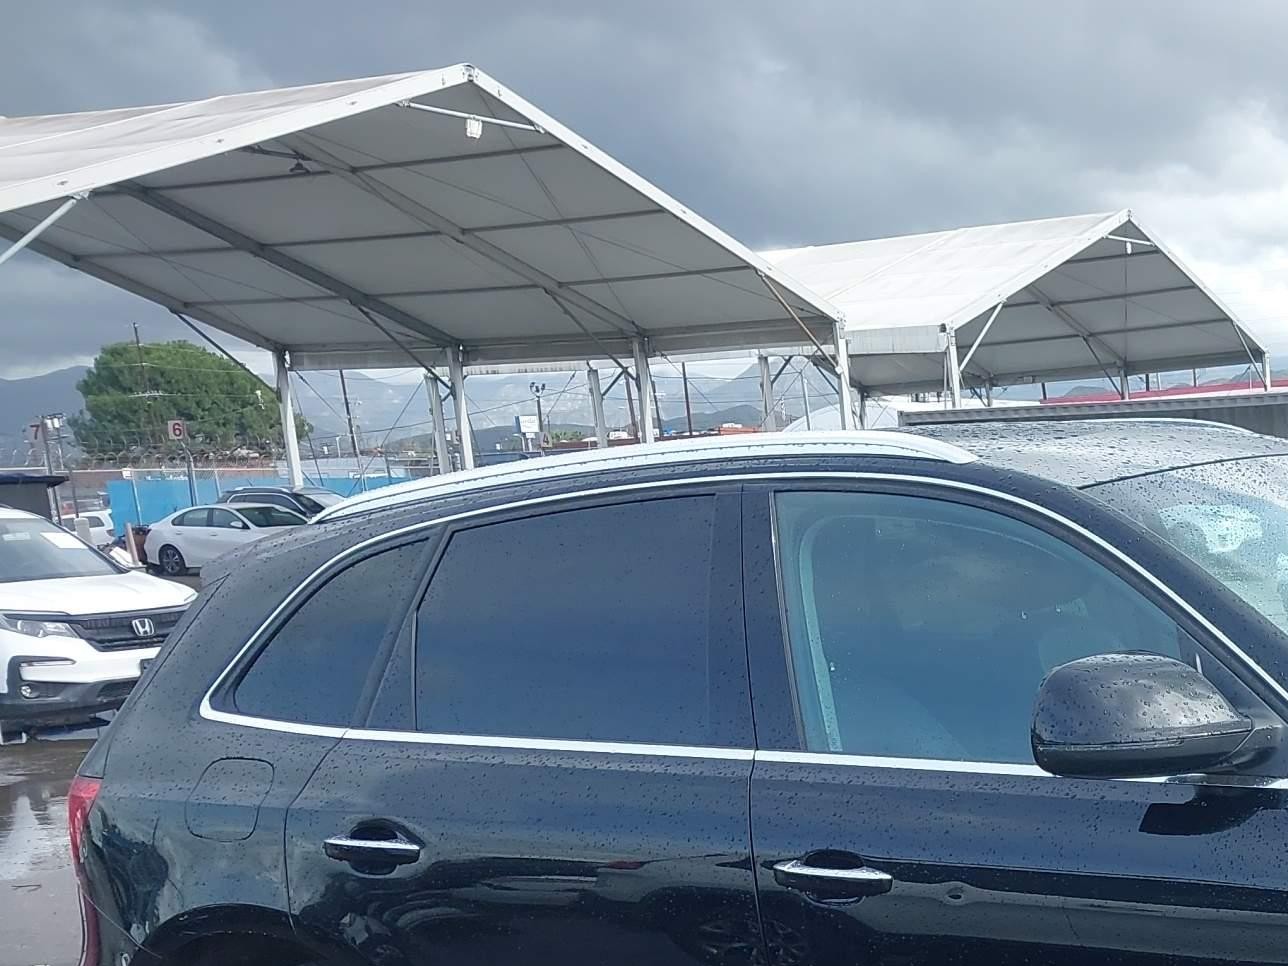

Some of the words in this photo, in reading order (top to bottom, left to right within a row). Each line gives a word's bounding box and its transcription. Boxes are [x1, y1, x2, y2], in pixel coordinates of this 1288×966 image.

[29, 424, 40, 440] 7
[172, 422, 182, 437] 6
[542, 433, 550, 445] 4
